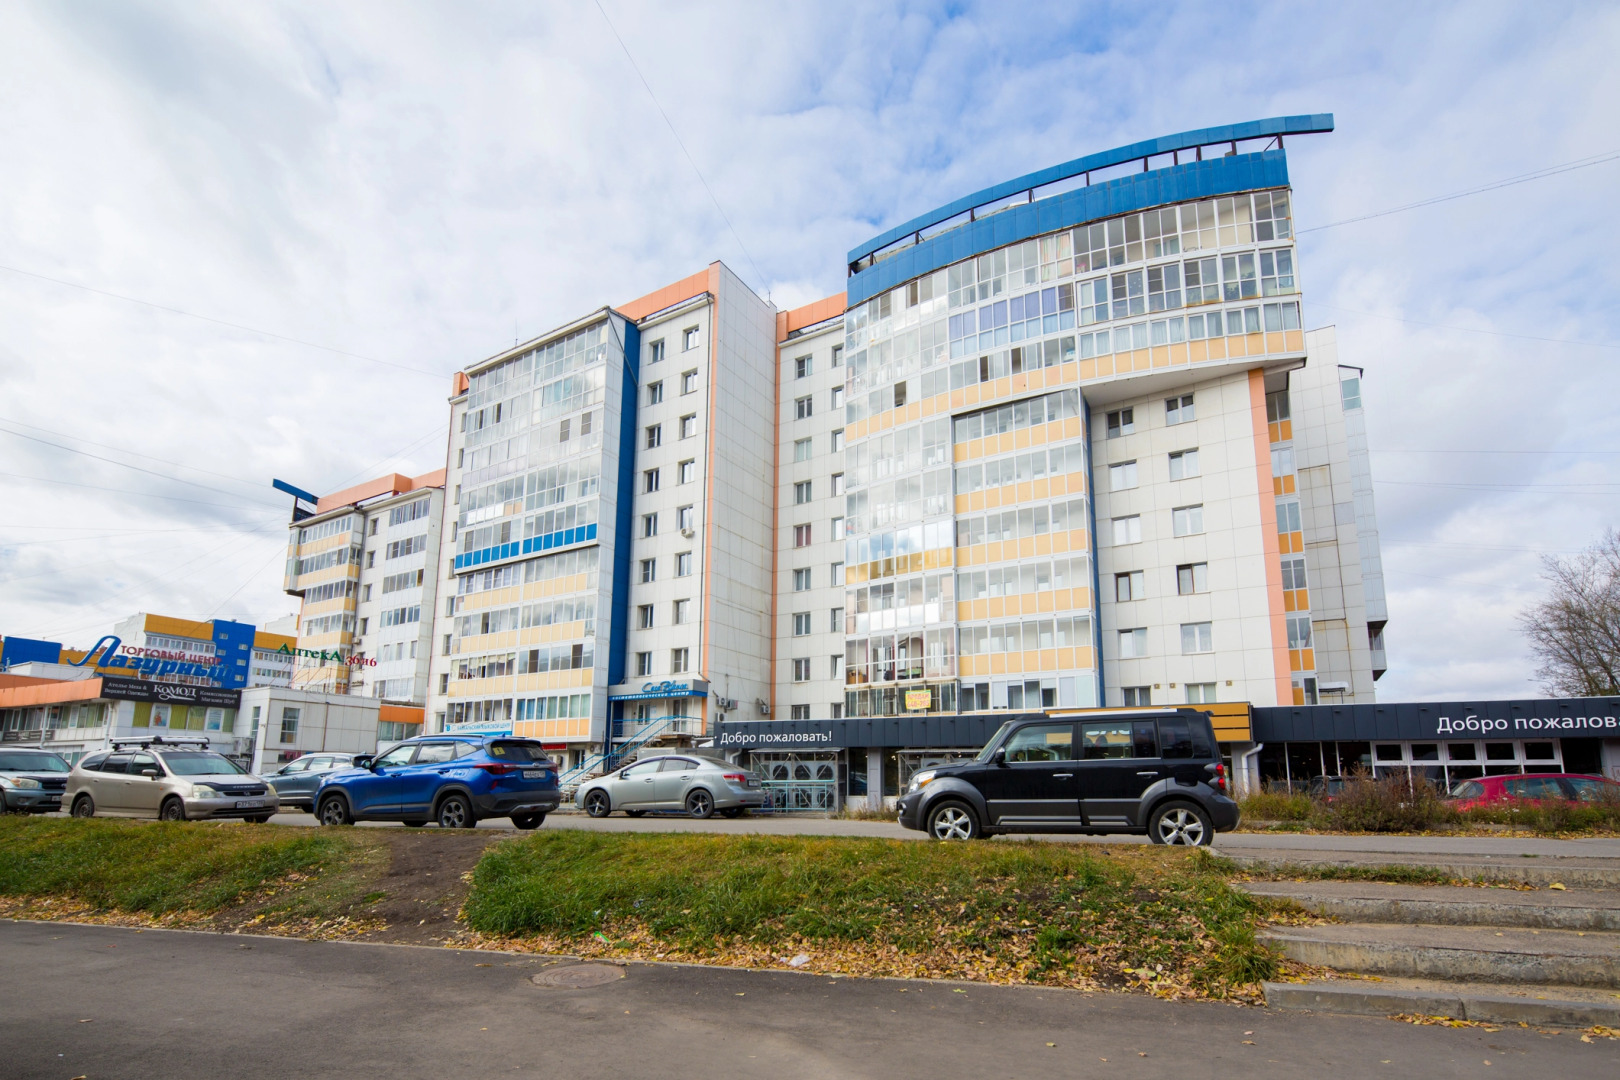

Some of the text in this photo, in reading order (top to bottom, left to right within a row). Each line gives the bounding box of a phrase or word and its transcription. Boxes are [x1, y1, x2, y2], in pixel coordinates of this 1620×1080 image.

[121, 645, 185, 661] ТОРГОВЫЙ
[1437, 715, 1620, 734] Добро пожалов
[720, 731, 832, 746] Добро пожаловать!
